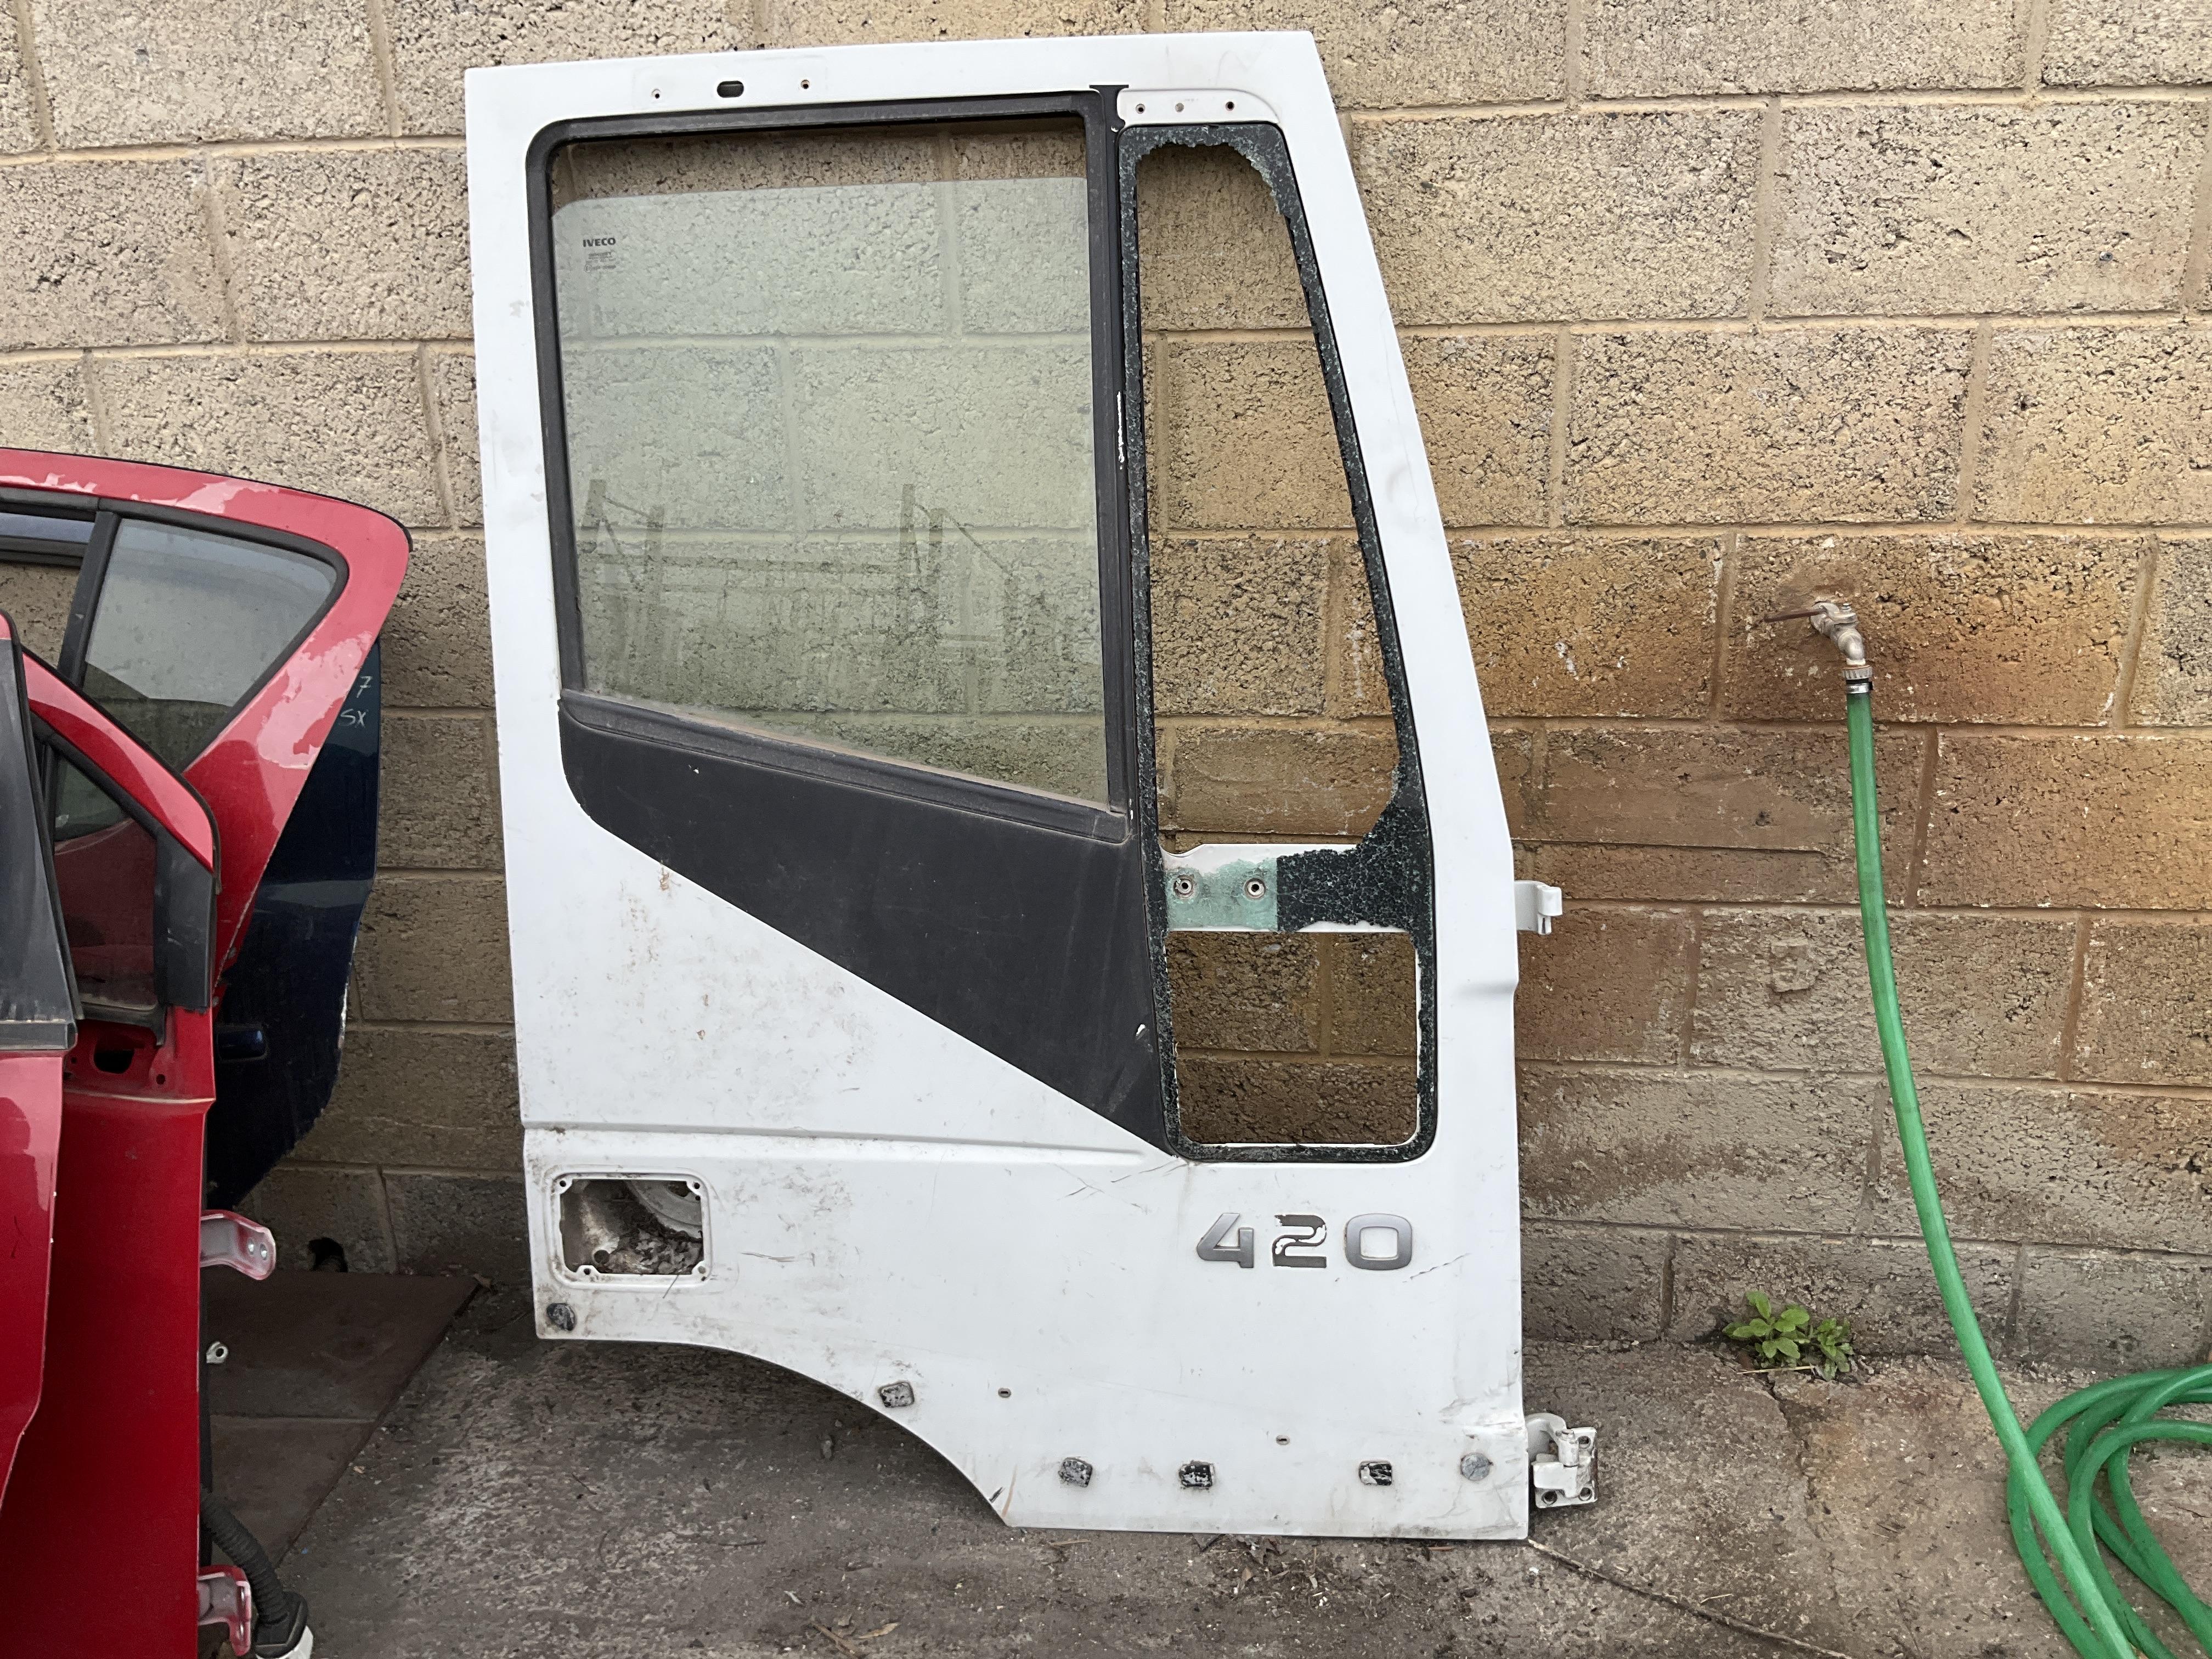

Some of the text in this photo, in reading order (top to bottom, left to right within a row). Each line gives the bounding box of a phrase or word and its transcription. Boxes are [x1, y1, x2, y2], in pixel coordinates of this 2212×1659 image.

[583, 238, 616, 247] IVECO
[356, 675, 373, 698] 7
[1196, 1212, 1413, 1271] 420
